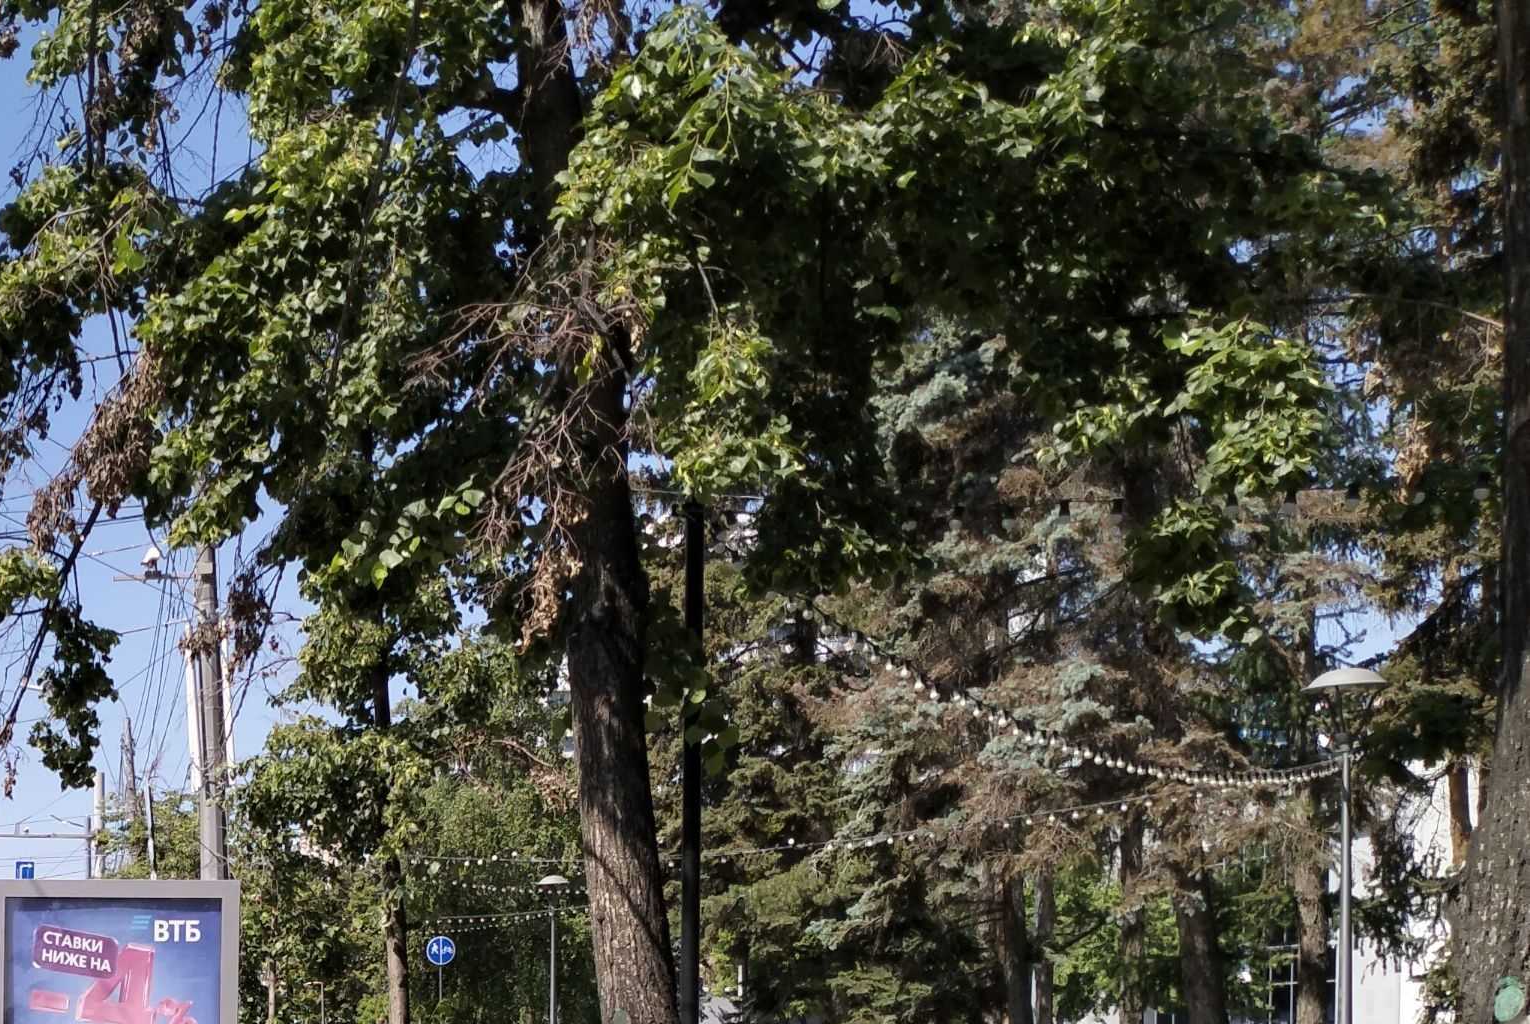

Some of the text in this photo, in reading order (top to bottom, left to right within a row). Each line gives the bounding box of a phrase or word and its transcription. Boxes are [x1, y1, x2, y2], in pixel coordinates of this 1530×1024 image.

[43, 930, 104, 954] СТАВКИ
[153, 919, 202, 943] ВТБ
[41, 948, 112, 973] НИЖЕ НА
